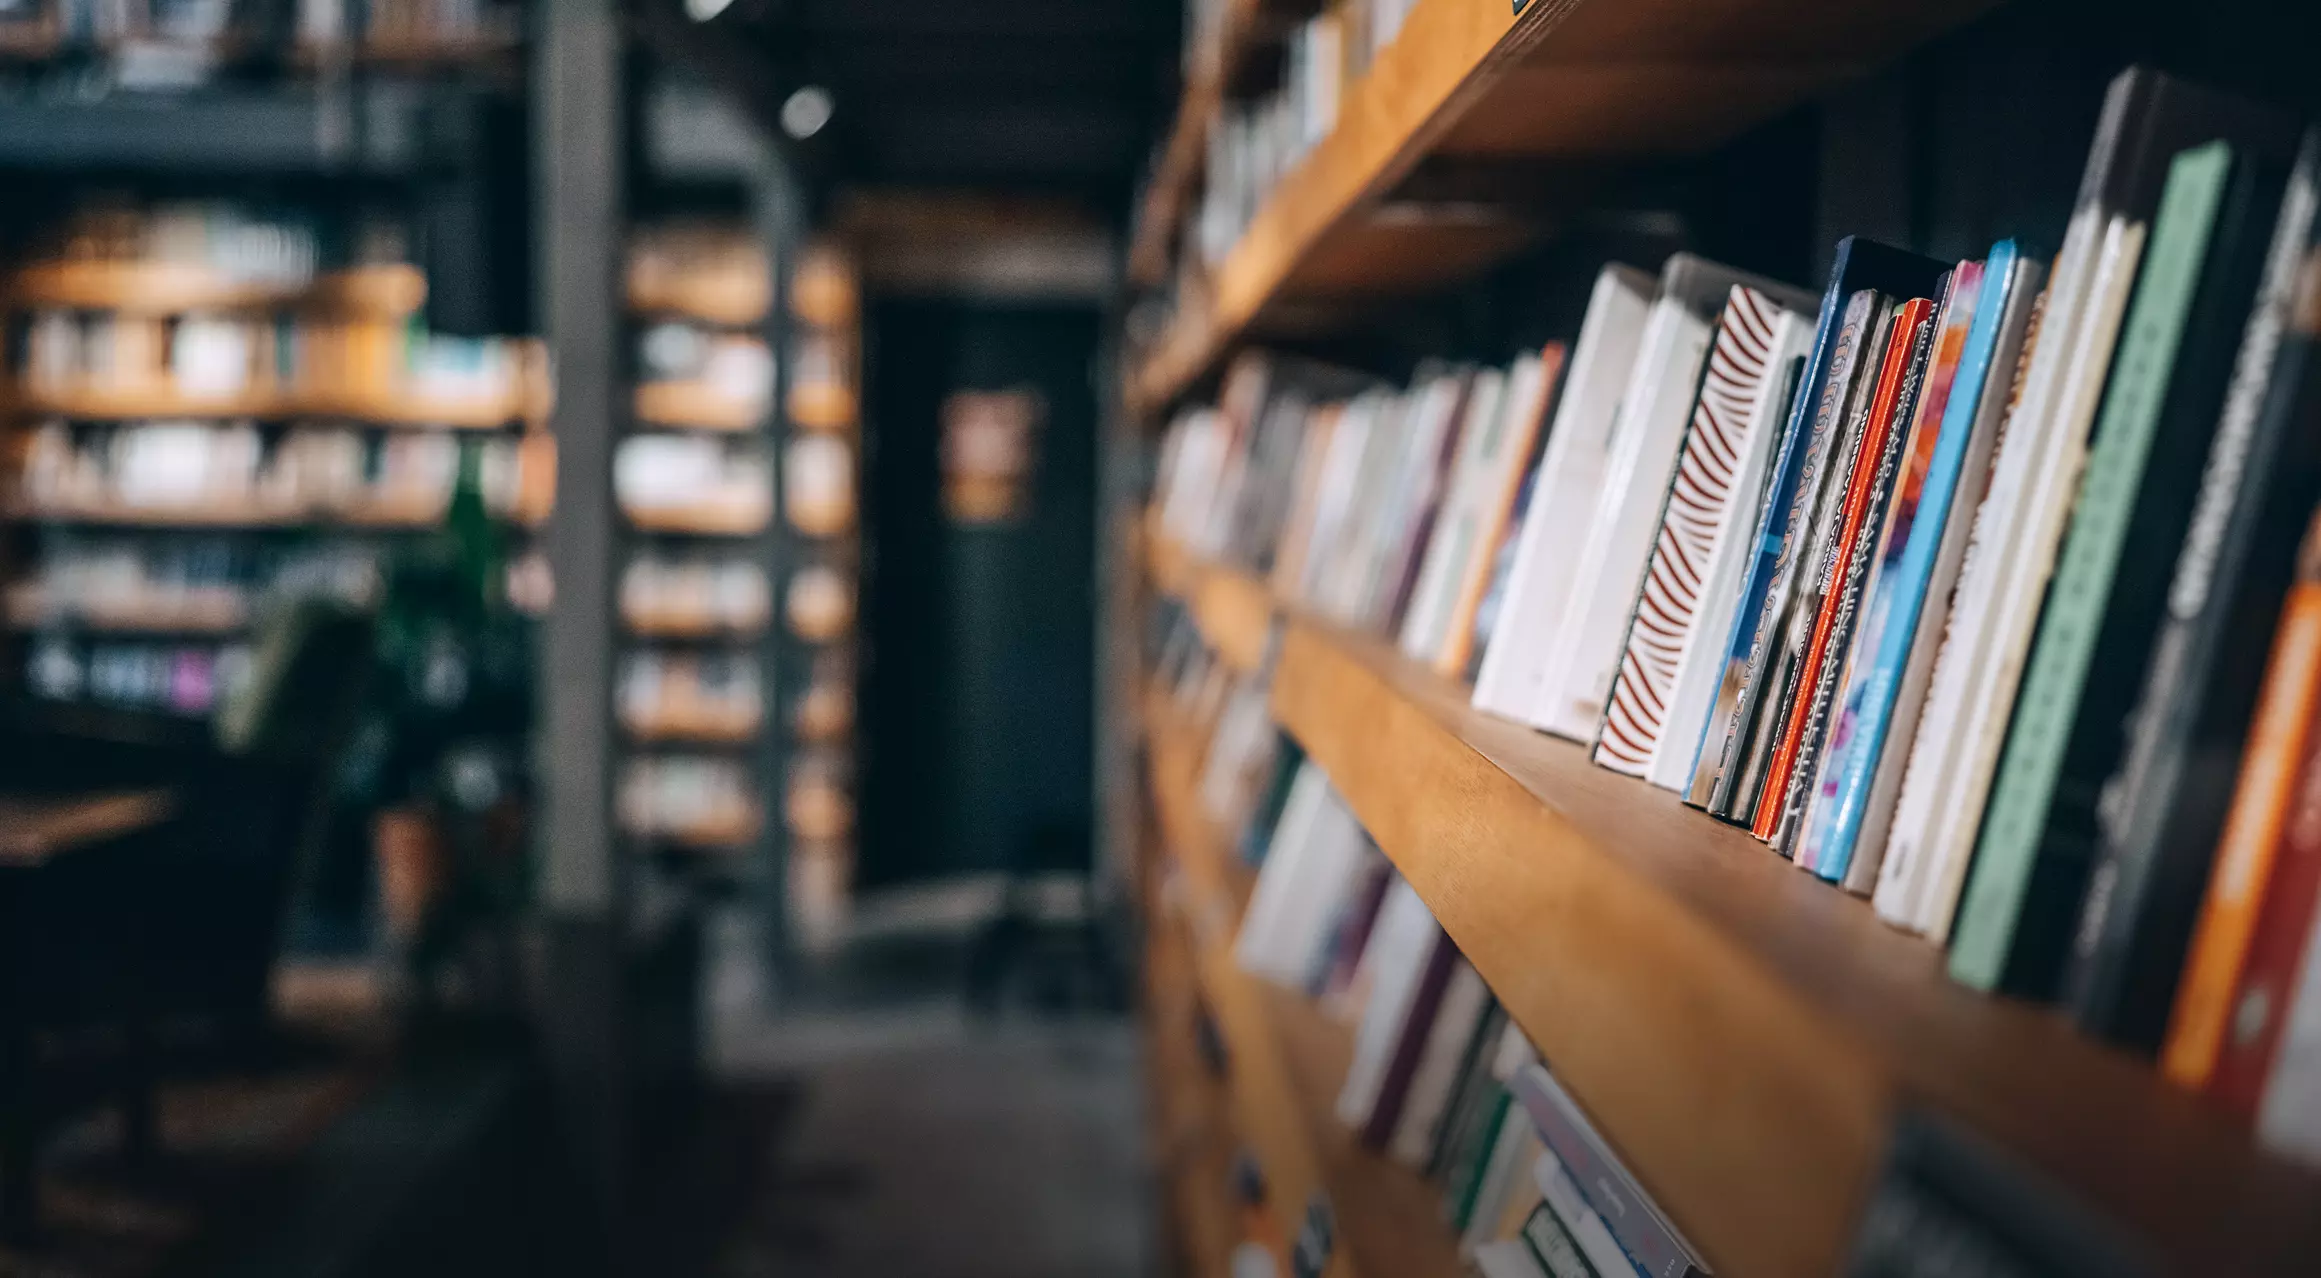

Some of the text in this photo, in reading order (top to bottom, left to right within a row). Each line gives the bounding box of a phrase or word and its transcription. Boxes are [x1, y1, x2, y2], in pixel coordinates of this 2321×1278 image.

[1816, 524, 1836, 586] KARMA
[1834, 501, 1843, 522] JA
[1854, 511, 1879, 580] SAMA
